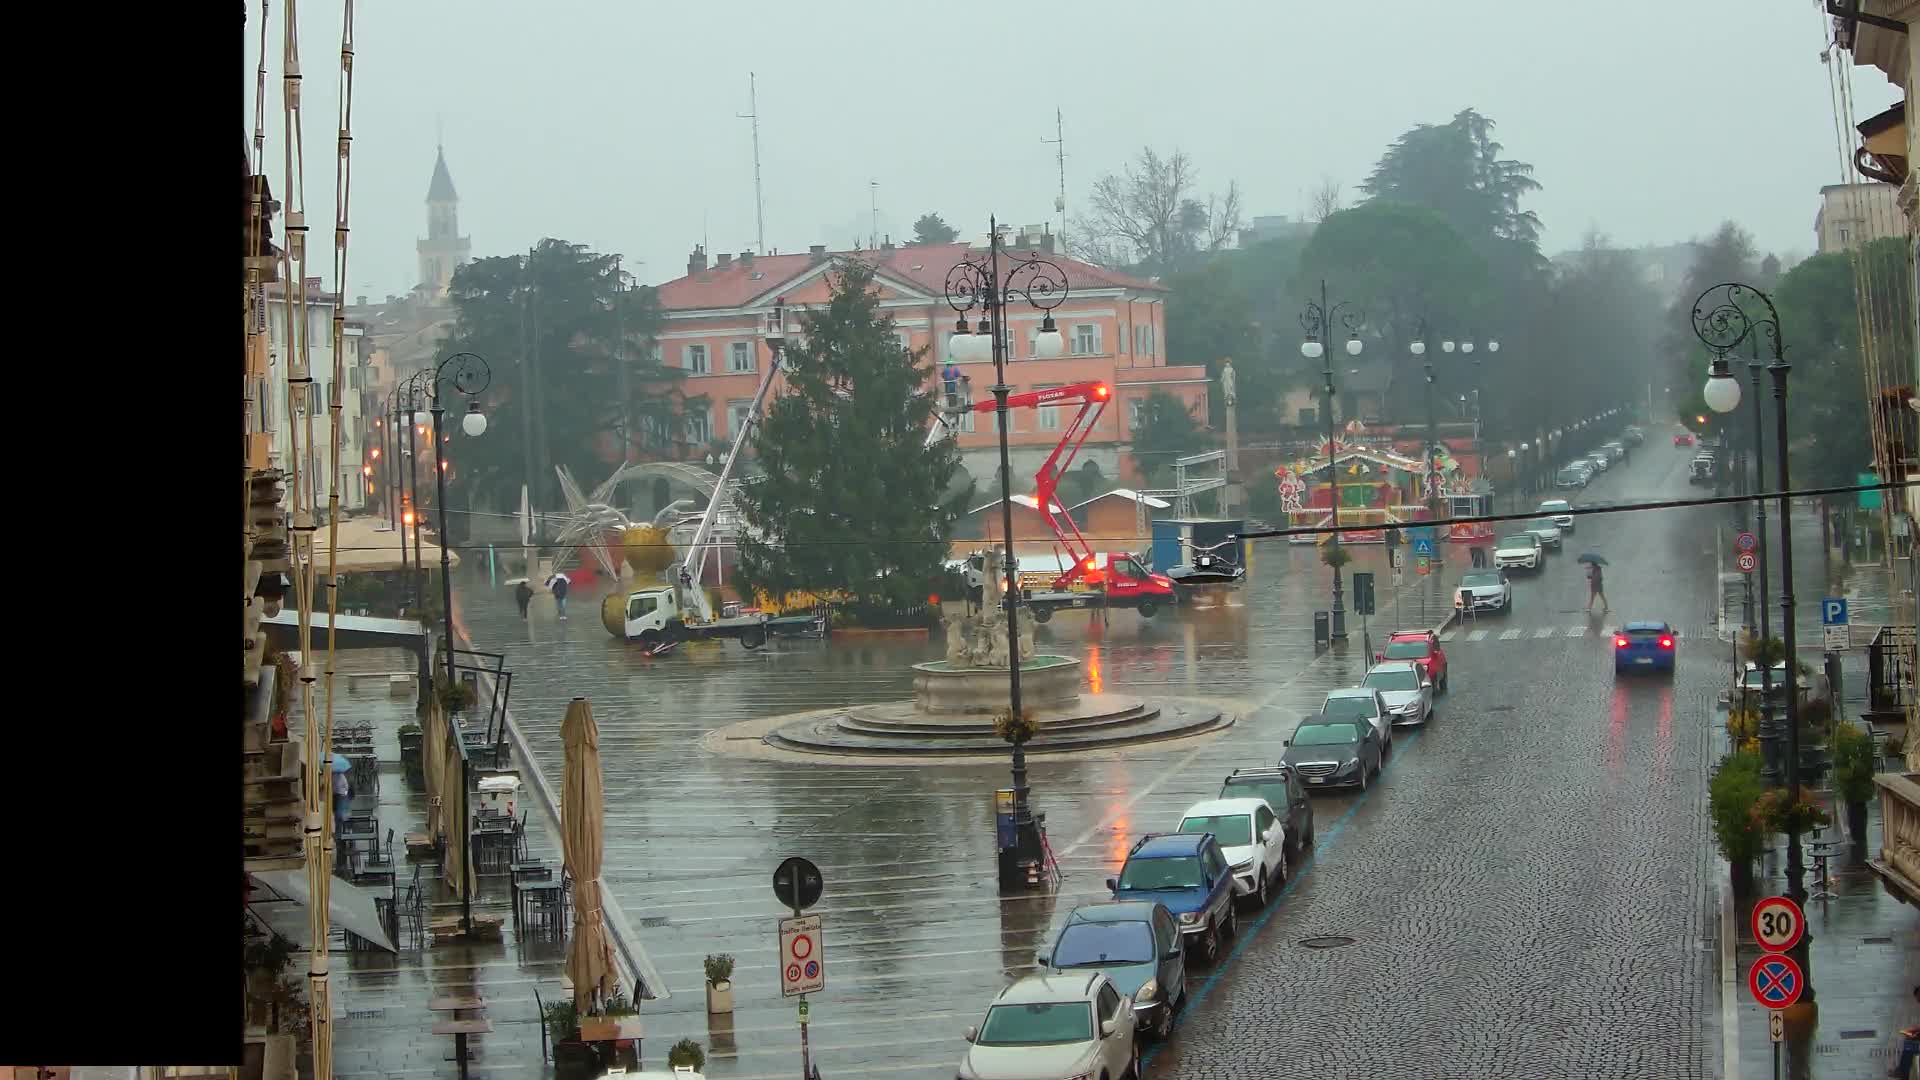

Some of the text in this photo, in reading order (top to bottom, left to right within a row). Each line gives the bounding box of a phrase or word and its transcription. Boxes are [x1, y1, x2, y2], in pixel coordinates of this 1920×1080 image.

[1742, 557, 1753, 567] 20
[1827, 602, 1842, 622] P
[1762, 911, 1792, 937] 30
